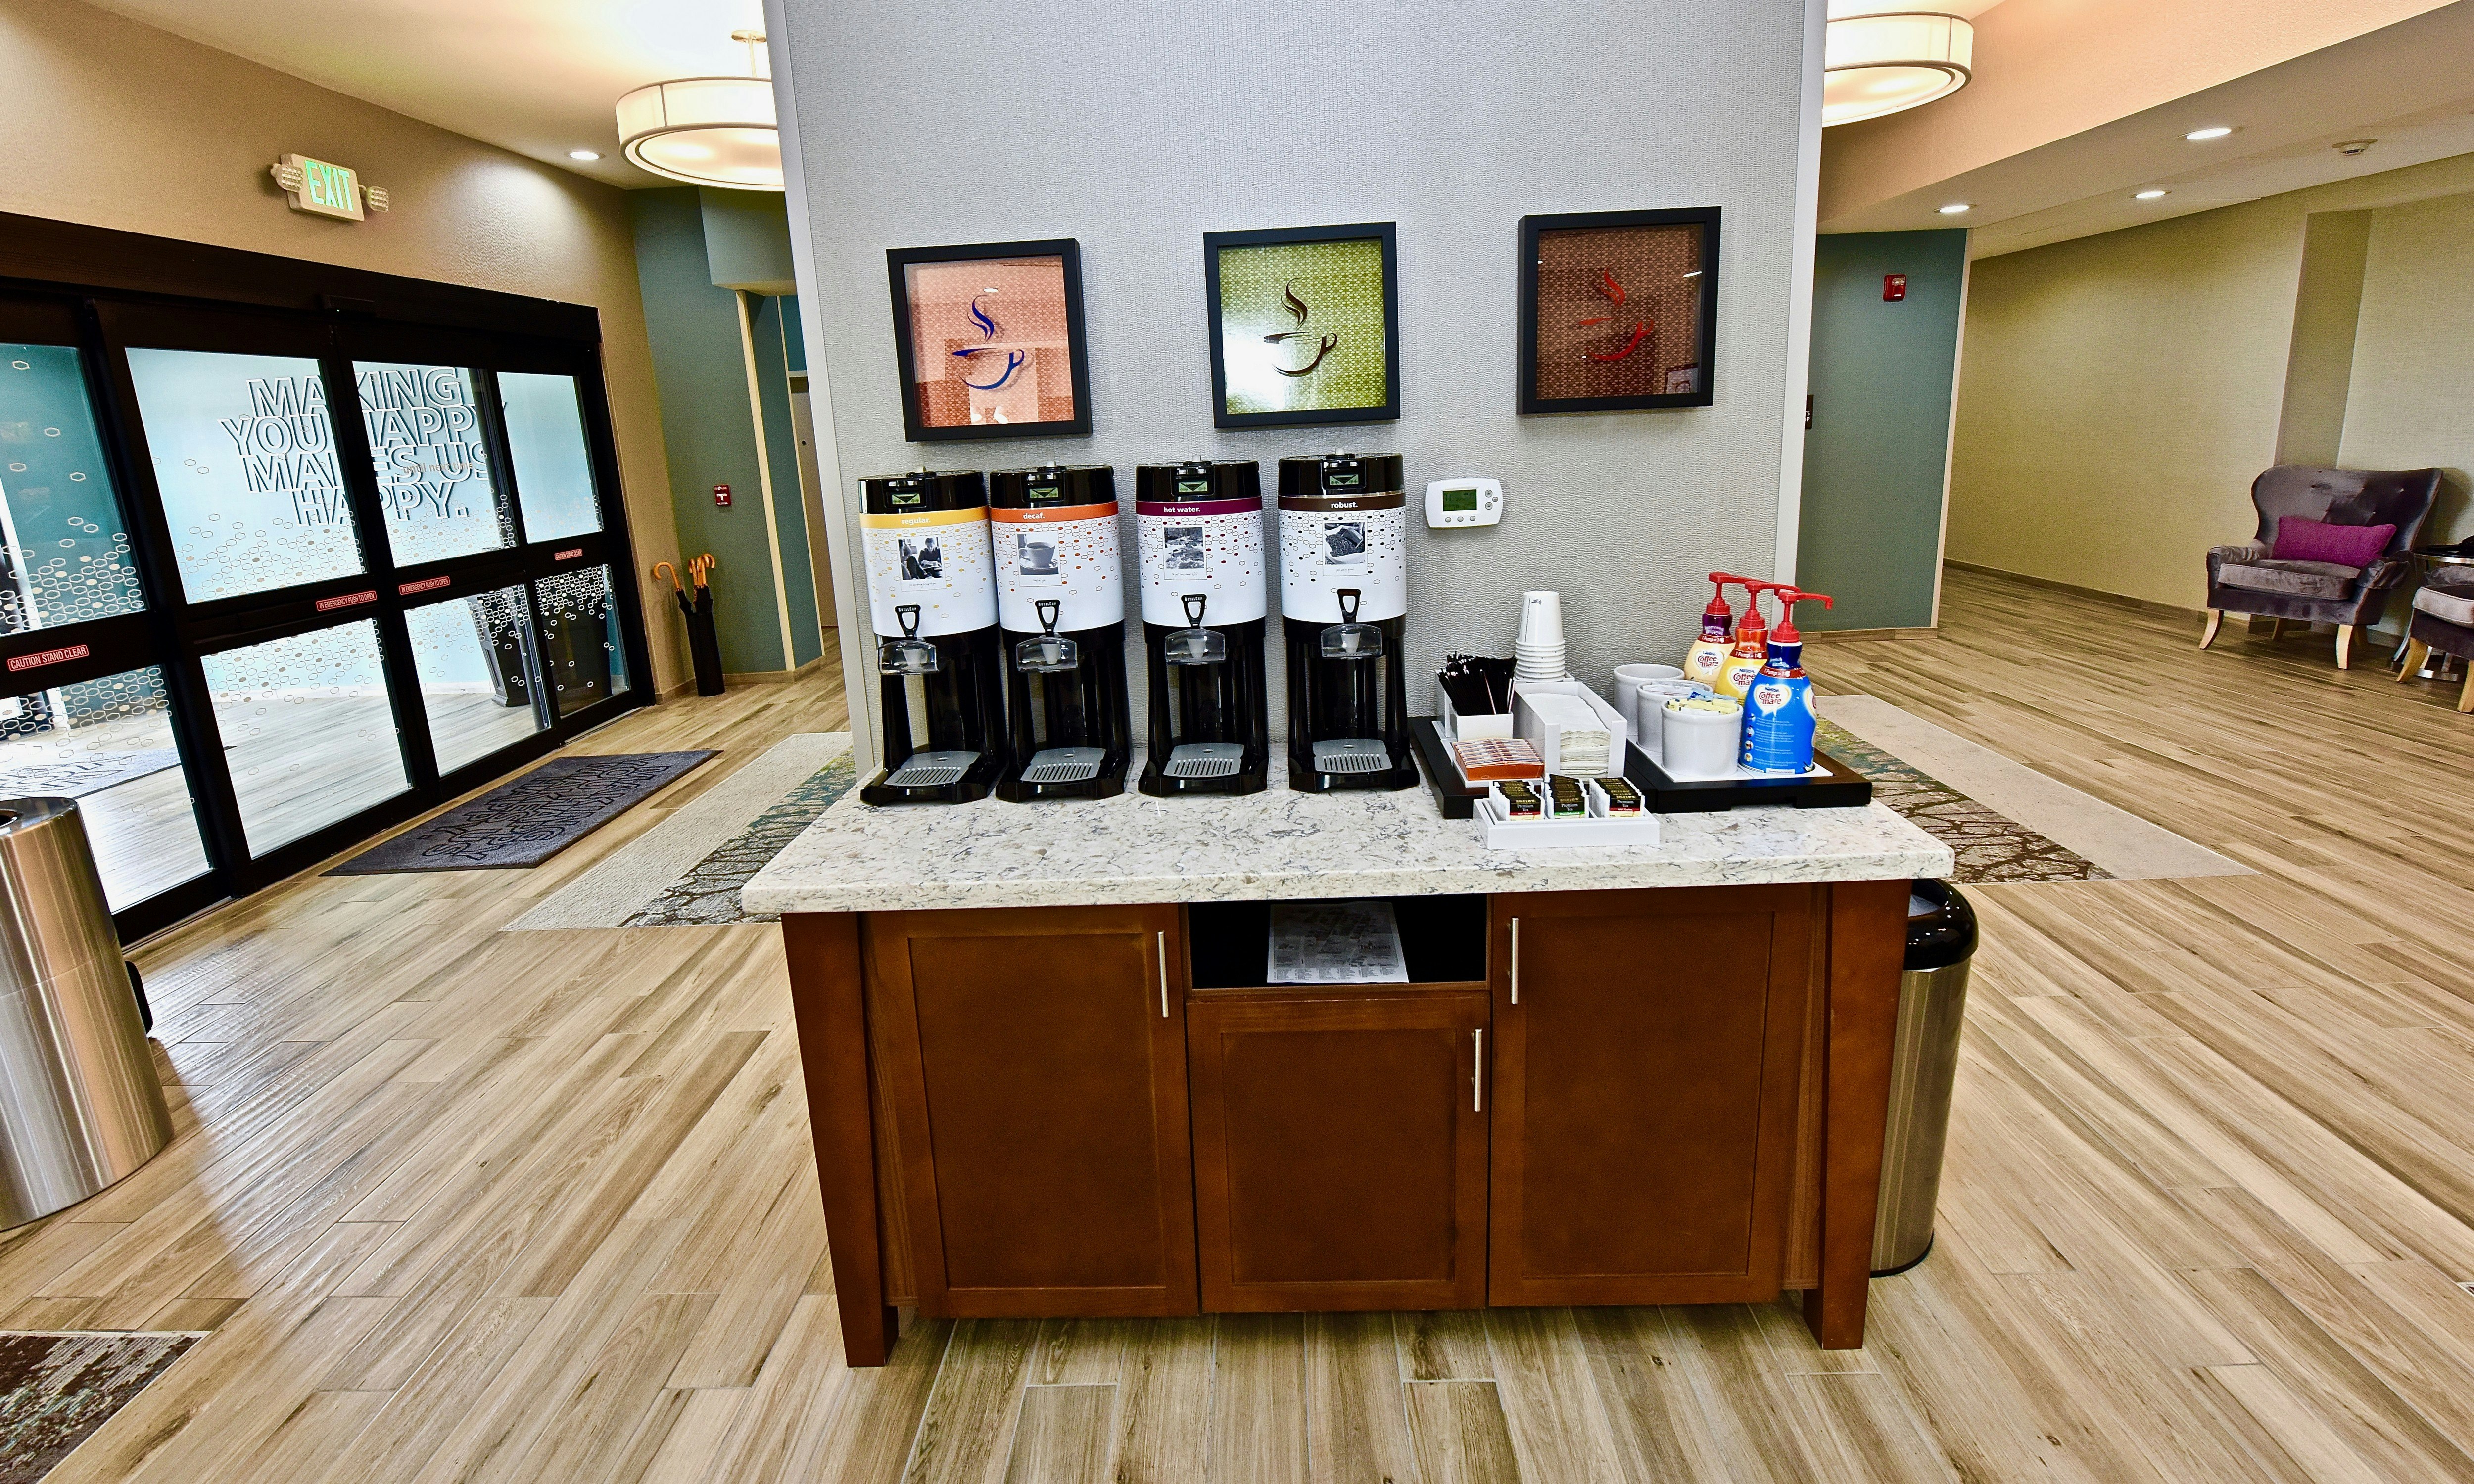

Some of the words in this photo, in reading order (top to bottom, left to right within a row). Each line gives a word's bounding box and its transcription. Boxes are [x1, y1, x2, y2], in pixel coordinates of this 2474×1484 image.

[305, 160, 354, 212] EXIT
[218, 413, 328, 458] YOU
[403, 463, 427, 473] until
[429, 463, 450, 472] next
[406, 582, 426, 592] EMERGENCY
[325, 598, 347, 608] EMERGENCY
[348, 595, 359, 603] PUSH
[10, 655, 42, 669] CAUTION
[42, 651, 64, 663] STAND
[64, 647, 87, 658] CLEAR
